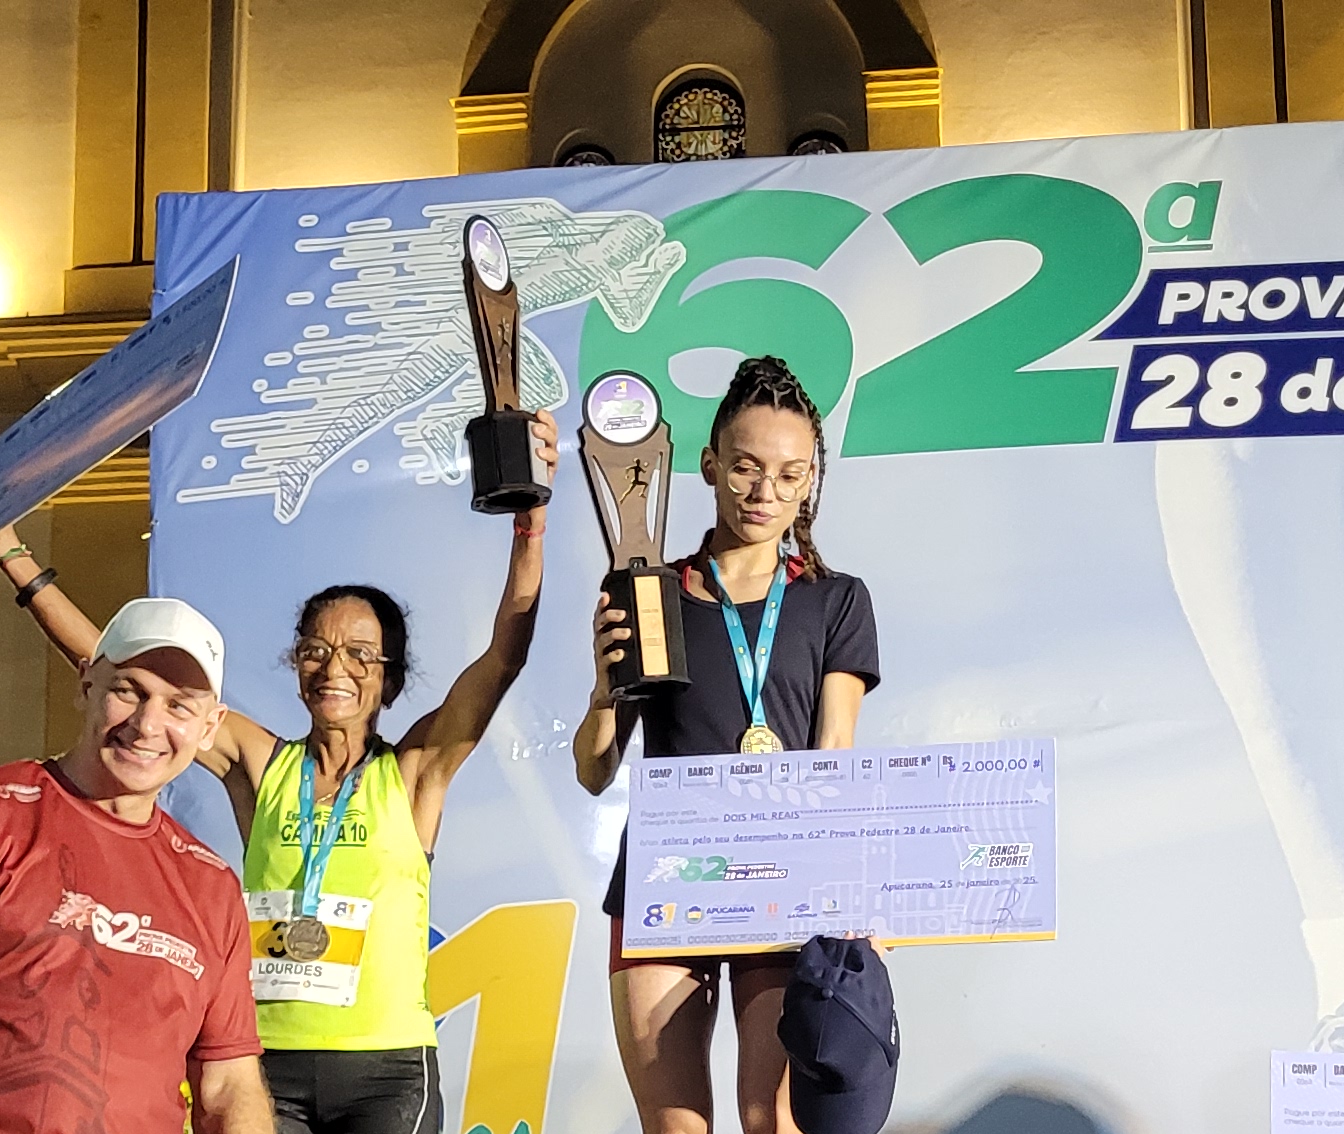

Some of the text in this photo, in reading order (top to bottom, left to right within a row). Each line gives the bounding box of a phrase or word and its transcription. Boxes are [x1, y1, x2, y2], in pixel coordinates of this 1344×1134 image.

[1131, 353, 1263, 428] 28
[688, 767, 714, 777] BANCO
[730, 762, 763, 775] AGÊNCIA
[781, 763, 789, 773] C1
[813, 761, 838, 771] CONTA
[862, 759, 872, 769] C2
[889, 758, 919, 768] CHEQUE
[723, 814, 746, 822] DOIS
[351, 824, 367, 842] 10
[693, 836, 711, 845] pelo
[733, 833, 788, 845] desempenho
[830, 830, 855, 838] Prova
[860, 828, 900, 837] Pedestre
[904, 826, 916, 835] 28
[920, 826, 930, 834] de
[989, 845, 1019, 856] BANCO
[988, 856, 1029, 867] ESPORTE
[746, 870, 786, 879] JANEIRO
[940, 880, 953, 888] 25
[643, 903, 677, 928] 81
[259, 963, 322, 976] LOURDES
[1292, 1064, 1318, 1075] COMP
